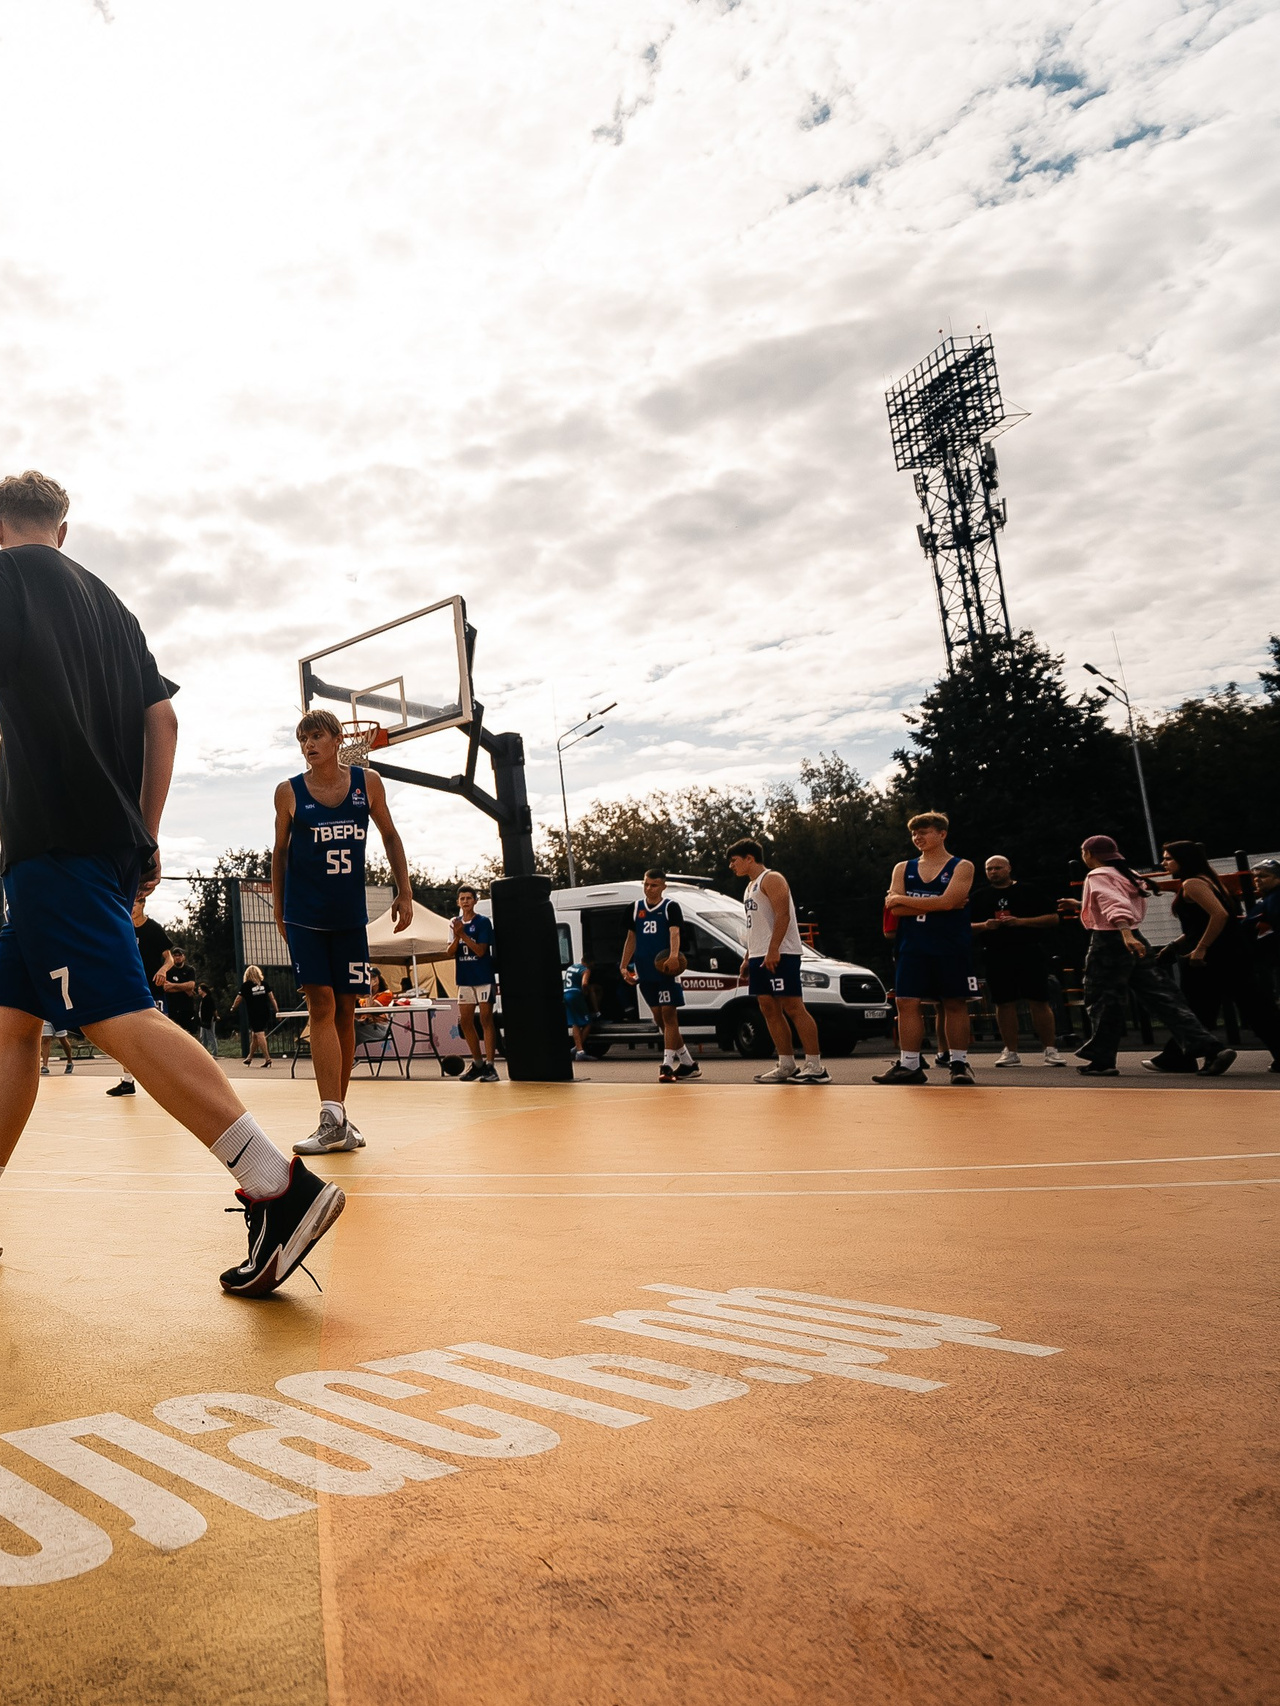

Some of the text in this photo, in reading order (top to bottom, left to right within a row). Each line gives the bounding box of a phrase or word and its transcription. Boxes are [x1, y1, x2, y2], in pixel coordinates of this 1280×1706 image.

[310, 824, 365, 843] ТВЕРЬ
[327, 850, 352, 874] 55
[643, 920, 657, 934] 28
[348, 962, 371, 985] 55
[49, 966, 73, 1010] 7
[682, 979, 724, 990] ОМОЩЬ
[770, 978, 785, 992] 13
[967, 976, 978, 991] 8
[658, 991, 671, 1003] 28
